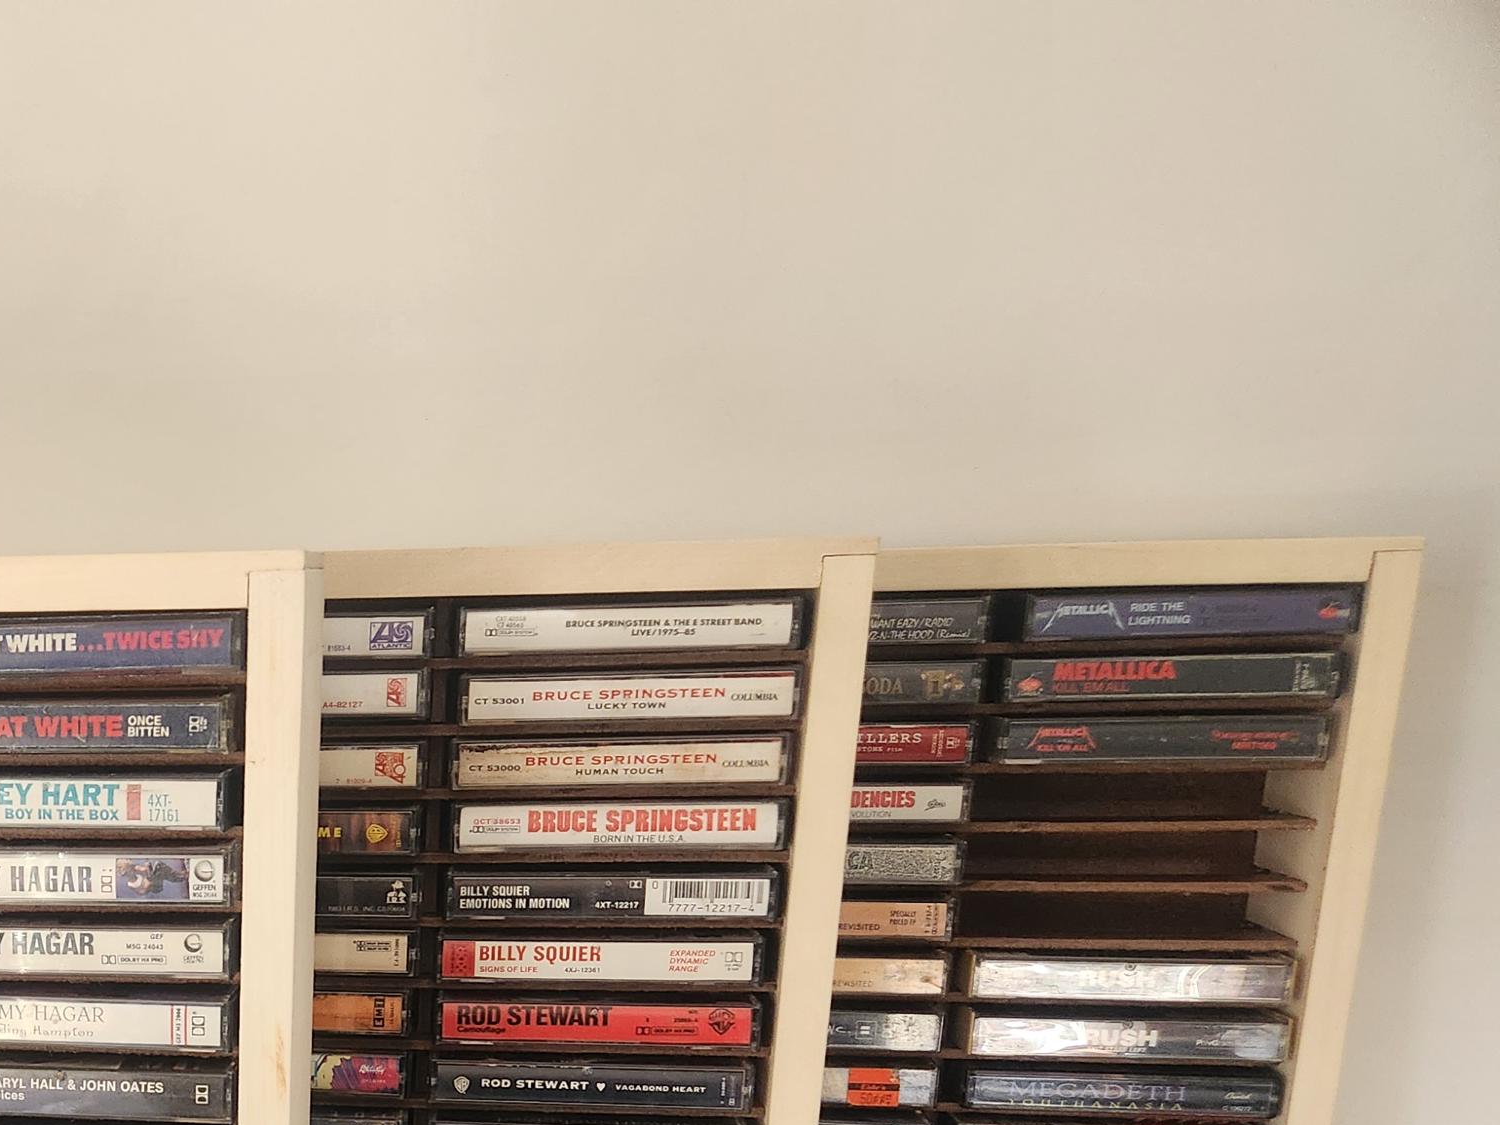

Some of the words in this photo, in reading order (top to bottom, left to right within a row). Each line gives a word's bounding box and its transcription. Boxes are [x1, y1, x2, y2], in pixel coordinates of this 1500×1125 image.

[1130, 603, 1158, 612] RIDE
[1161, 602, 1184, 612] THE
[1128, 613, 1191, 626] LIGHTNING
[1053, 661, 1179, 681] METALLICA
[532, 690, 594, 701] BRUCE
[599, 688, 726, 700] SPRINGSTEEN
[587, 702, 625, 710] LUCKY
[630, 702, 666, 710] TOWN
[127, 715, 162, 726] ONCE
[127, 724, 170, 738] BITTEN
[39, 783, 120, 807] HART
[4, 807, 35, 820] BOY
[38, 808, 52, 820] IN
[56, 808, 85, 821] THE
[87, 808, 119, 821] BOX
[593, 834, 620, 843] BORN
[620, 834, 632, 843] IN
[633, 834, 655, 843] THE
[460, 886, 488, 896] BILLY
[492, 886, 530, 896] SQUIER
[460, 899, 513, 909] EMOTIONS
[514, 899, 527, 909] IN
[528, 898, 570, 909] MOTION
[594, 901, 639, 909] 4XT-12217
[12, 932, 95, 955] HAGAR
[30, 1079, 65, 1091] HALL
[68, 1080, 77, 1092] &
[80, 1080, 118, 1092] JOHN
[121, 1080, 164, 1094] OATES
[672, 1085, 706, 1093] HEART
